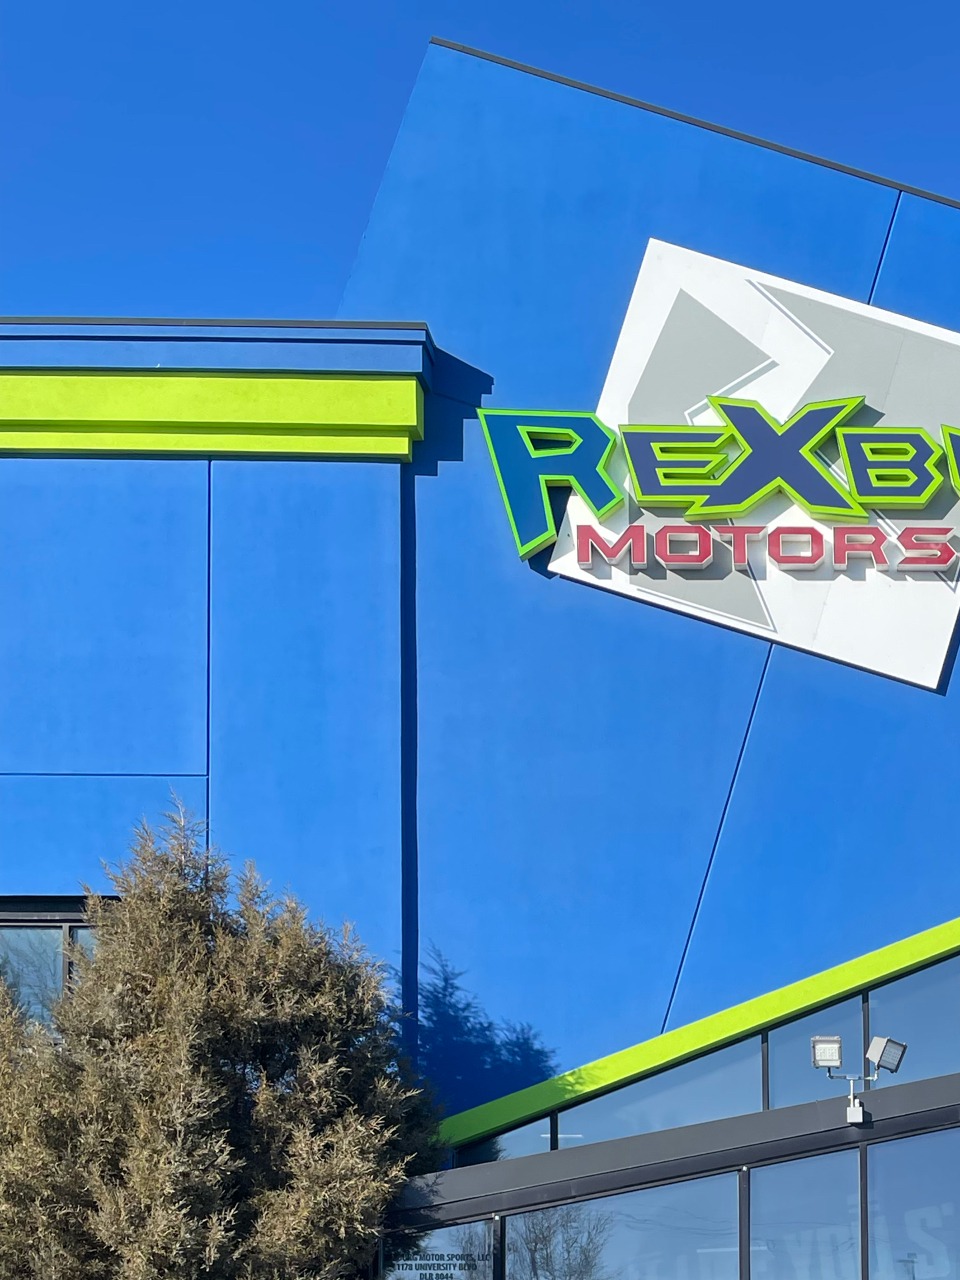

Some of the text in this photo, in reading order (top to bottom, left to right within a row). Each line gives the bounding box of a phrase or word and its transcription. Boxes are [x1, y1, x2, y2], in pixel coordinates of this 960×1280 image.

[419, 1254, 445, 1262] MOTOR
[477, 1254, 490, 1262] LLC
[414, 1263, 457, 1271] UNIVERSITY
[458, 1263, 478, 1271] BLVD
[419, 1273, 454, 1280] DLR 8044
